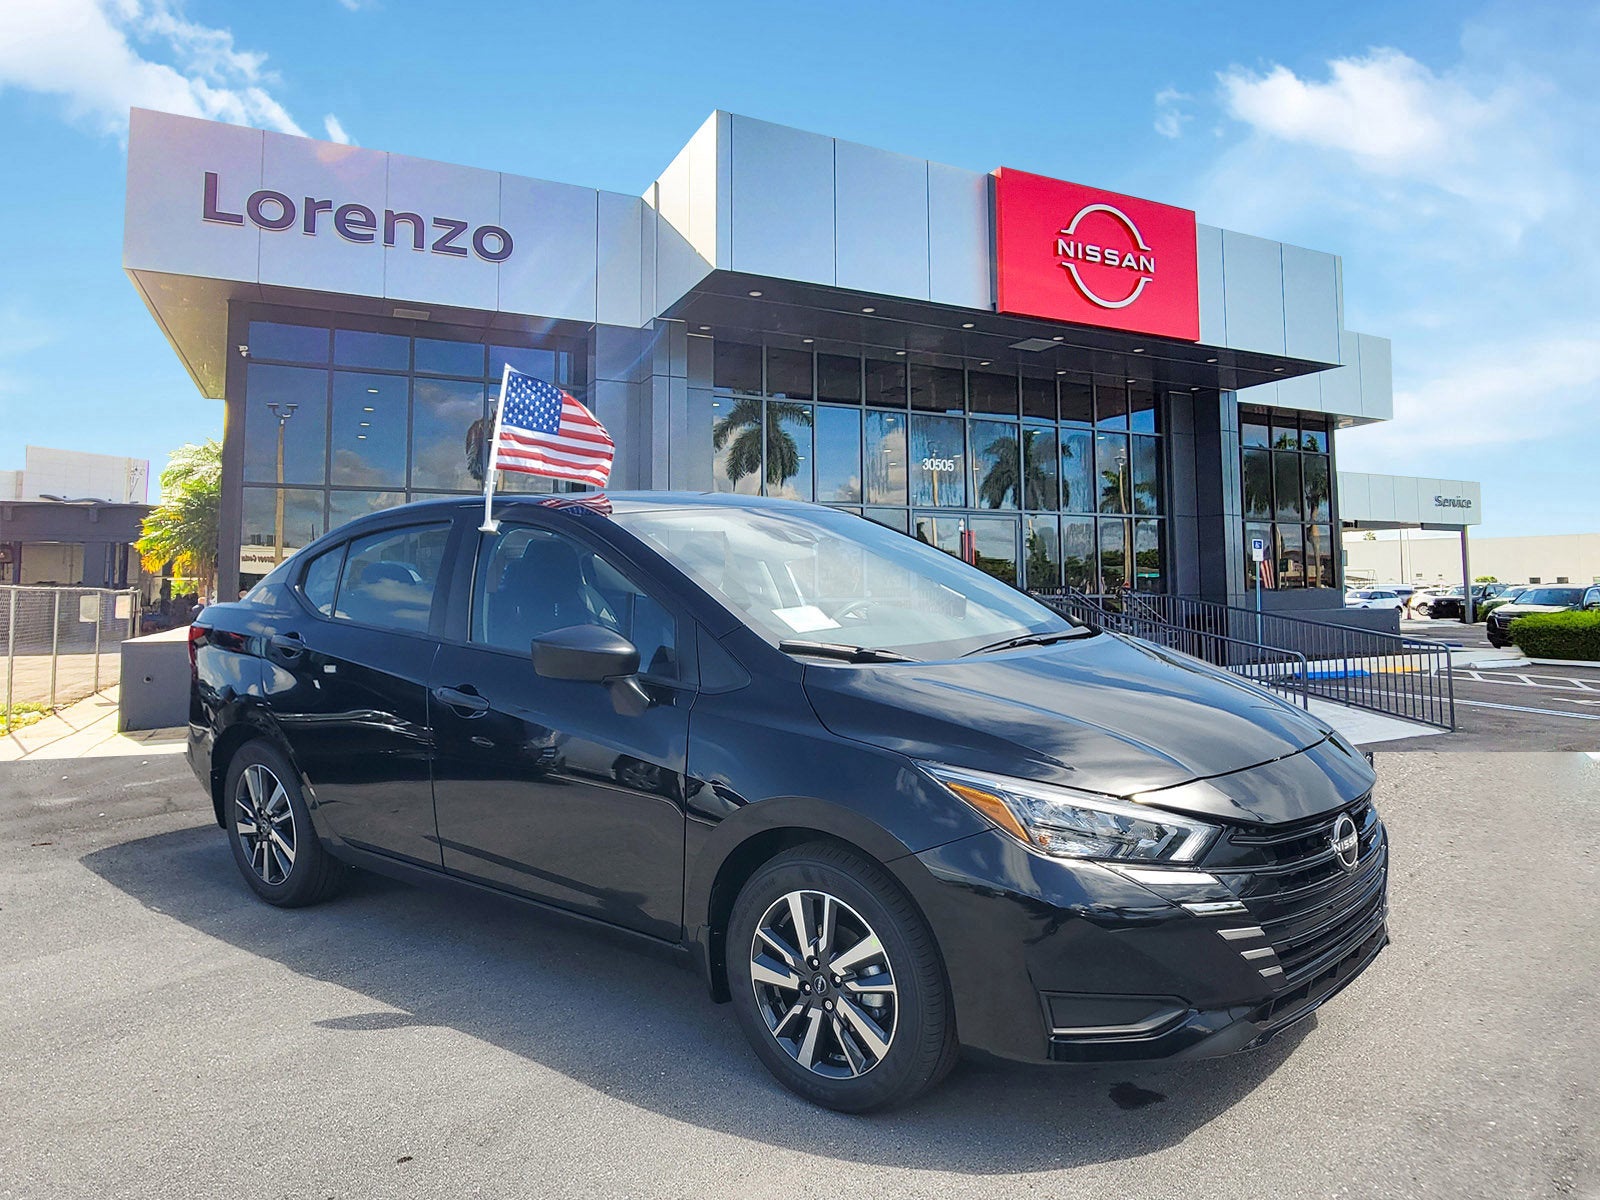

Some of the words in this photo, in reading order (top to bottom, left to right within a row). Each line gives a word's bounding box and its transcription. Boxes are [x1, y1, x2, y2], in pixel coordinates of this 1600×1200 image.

[202, 171, 514, 262] Lorenzo
[1057, 238, 1155, 273] NISSAN
[922, 458, 954, 471] 30505
[1434, 495, 1472, 508] Service
